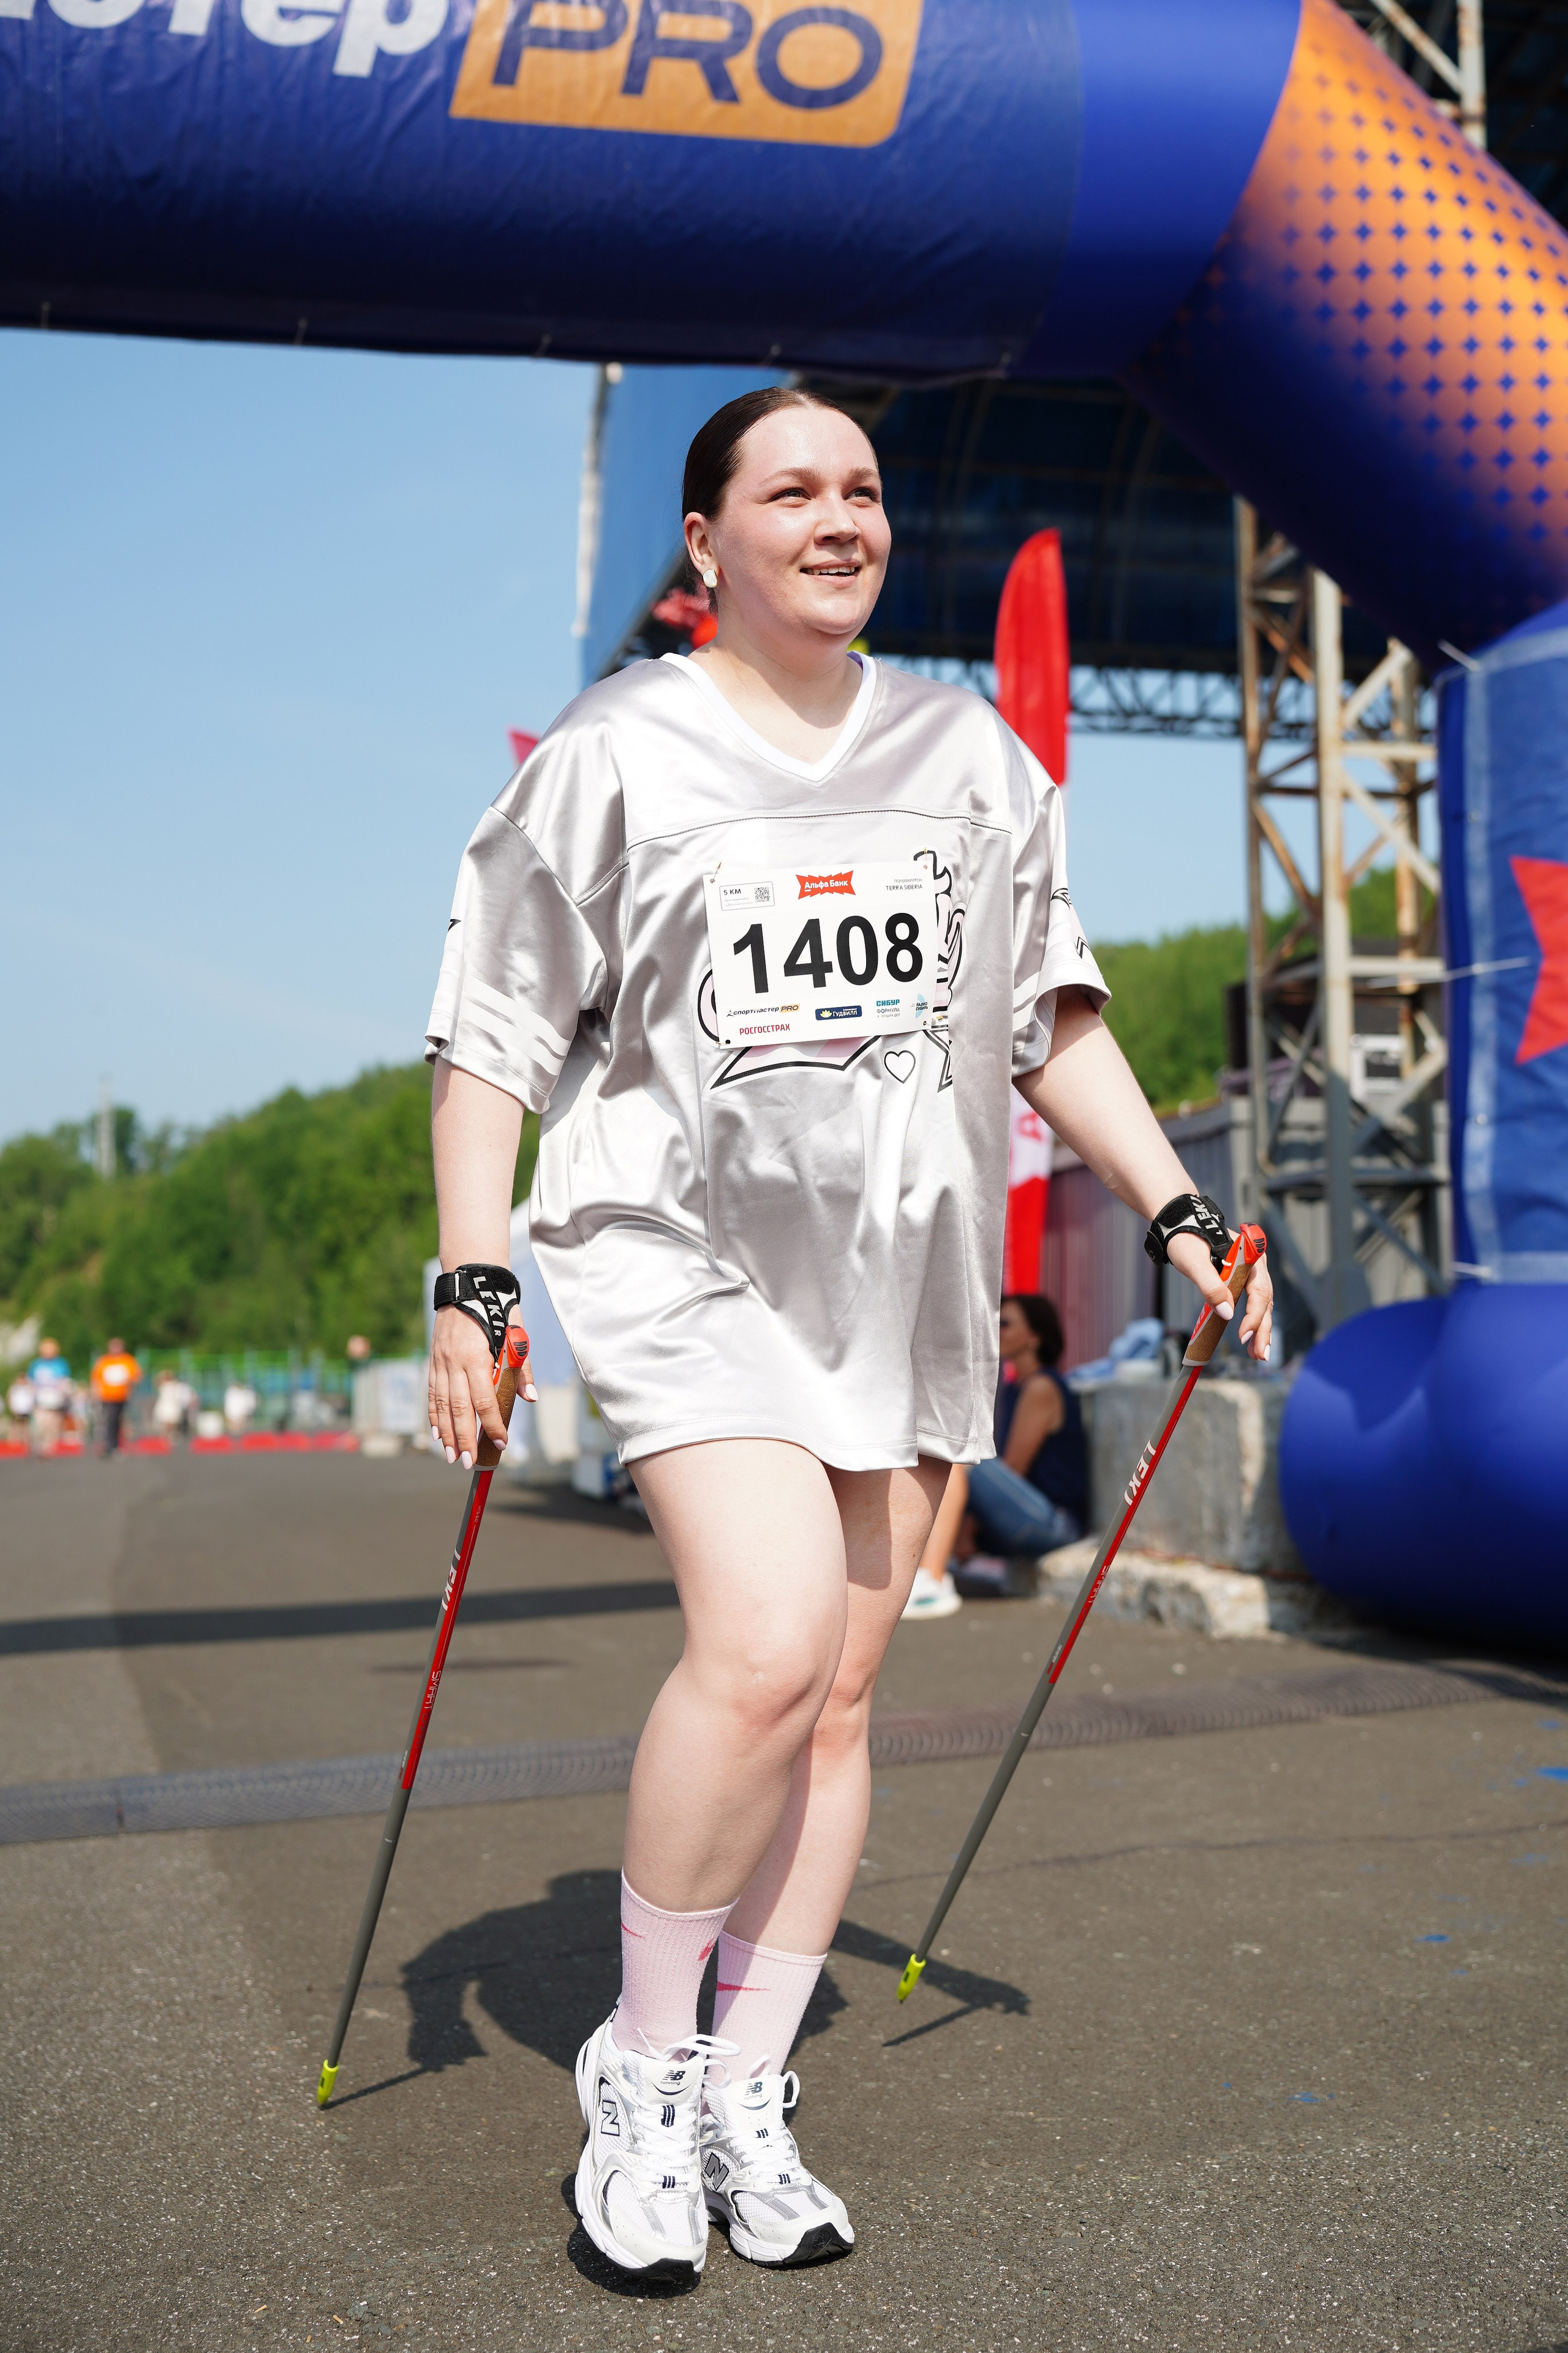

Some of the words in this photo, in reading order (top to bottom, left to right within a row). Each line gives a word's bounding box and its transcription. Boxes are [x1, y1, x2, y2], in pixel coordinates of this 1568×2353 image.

[492, 0, 884, 110] PRO
[804, 880, 829, 891] Альфа
[733, 912, 923, 994] 1408
[739, 1024, 790, 1035] РОСГОССТРАХ
[1189, 1196, 1219, 1229] LEKI
[473, 1276, 505, 1328] LEKI
[1124, 1440, 1157, 1506] LEKI
[424, 1670, 442, 1710] SMART
